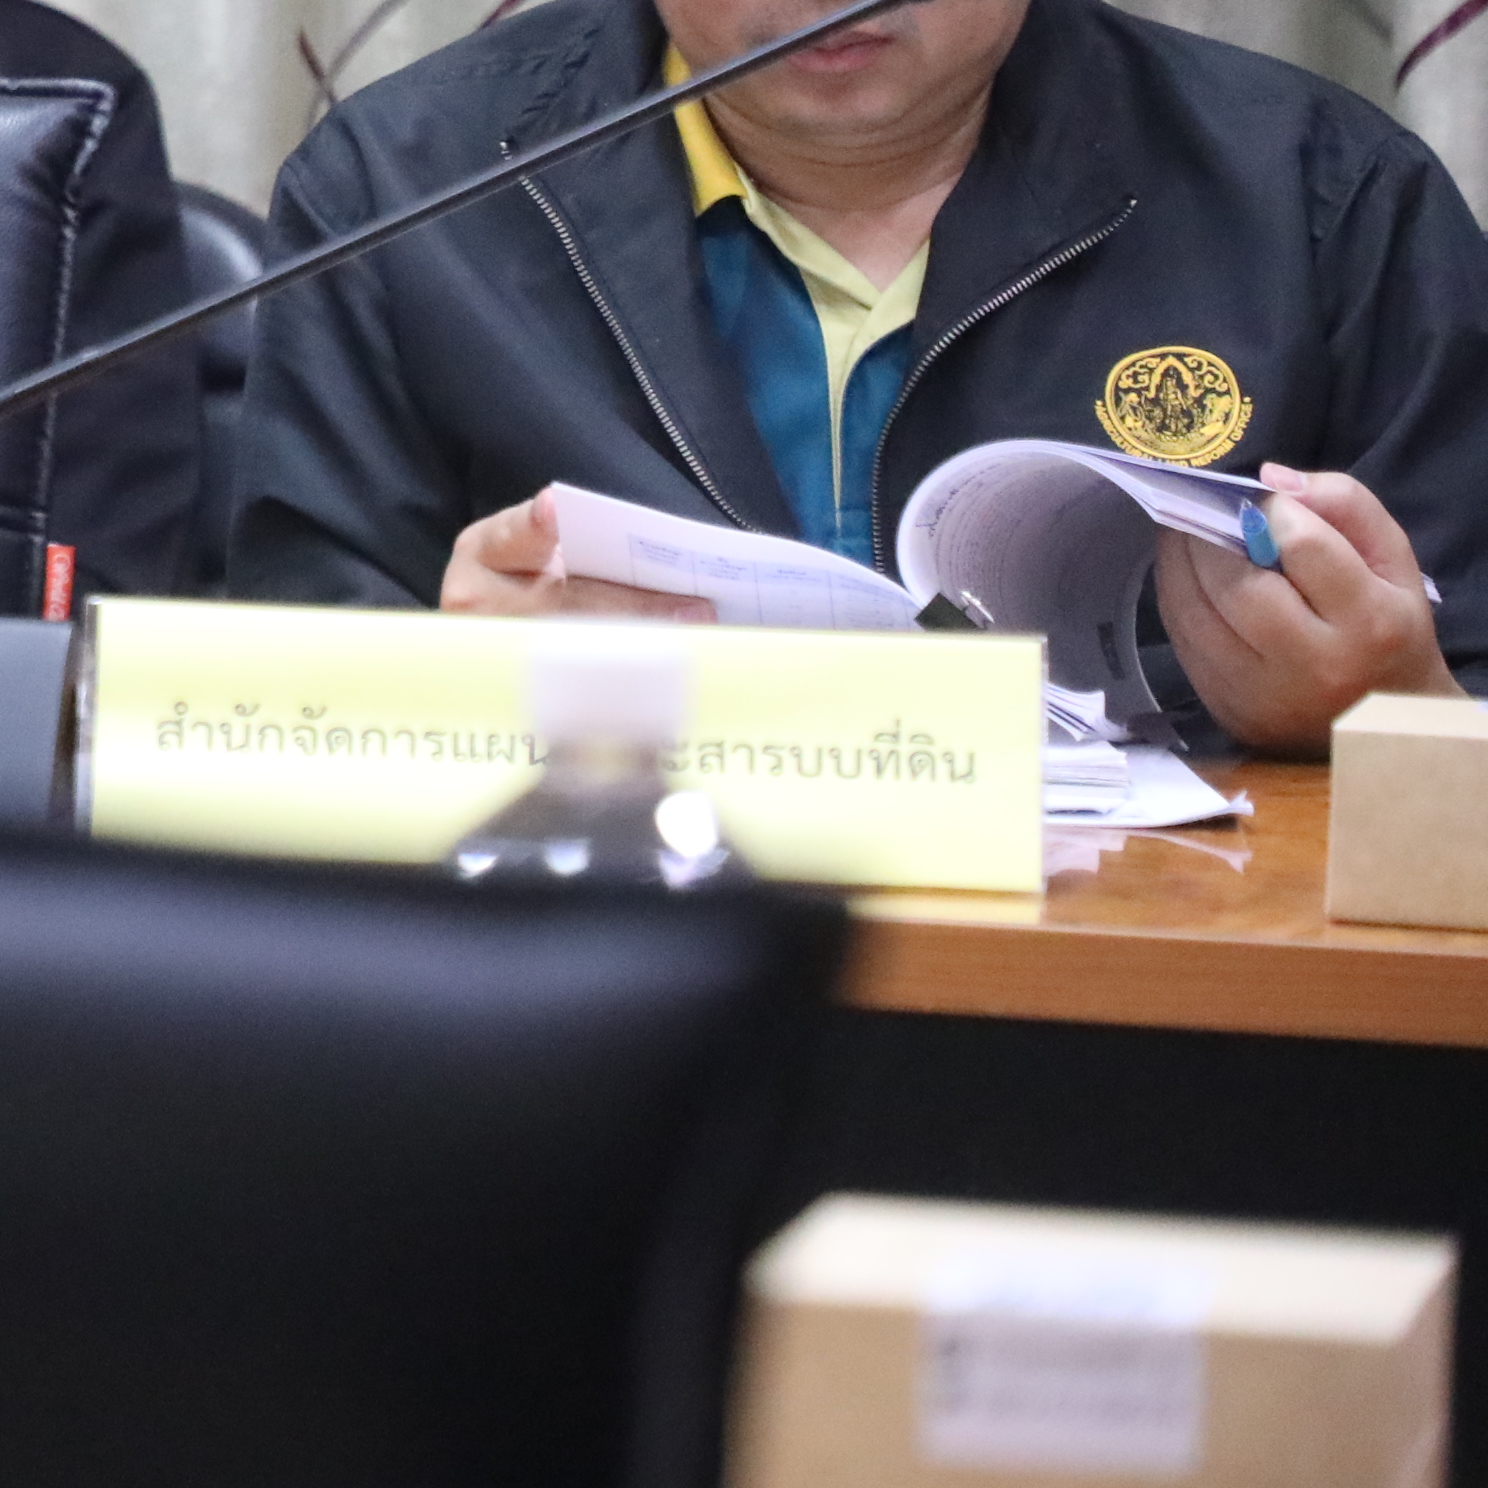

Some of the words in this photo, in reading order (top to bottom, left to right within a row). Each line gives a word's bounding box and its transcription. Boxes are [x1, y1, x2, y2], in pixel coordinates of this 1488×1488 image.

[156, 700, 977, 784] สำนักจัดการแผนะสารบบที่ดิน
